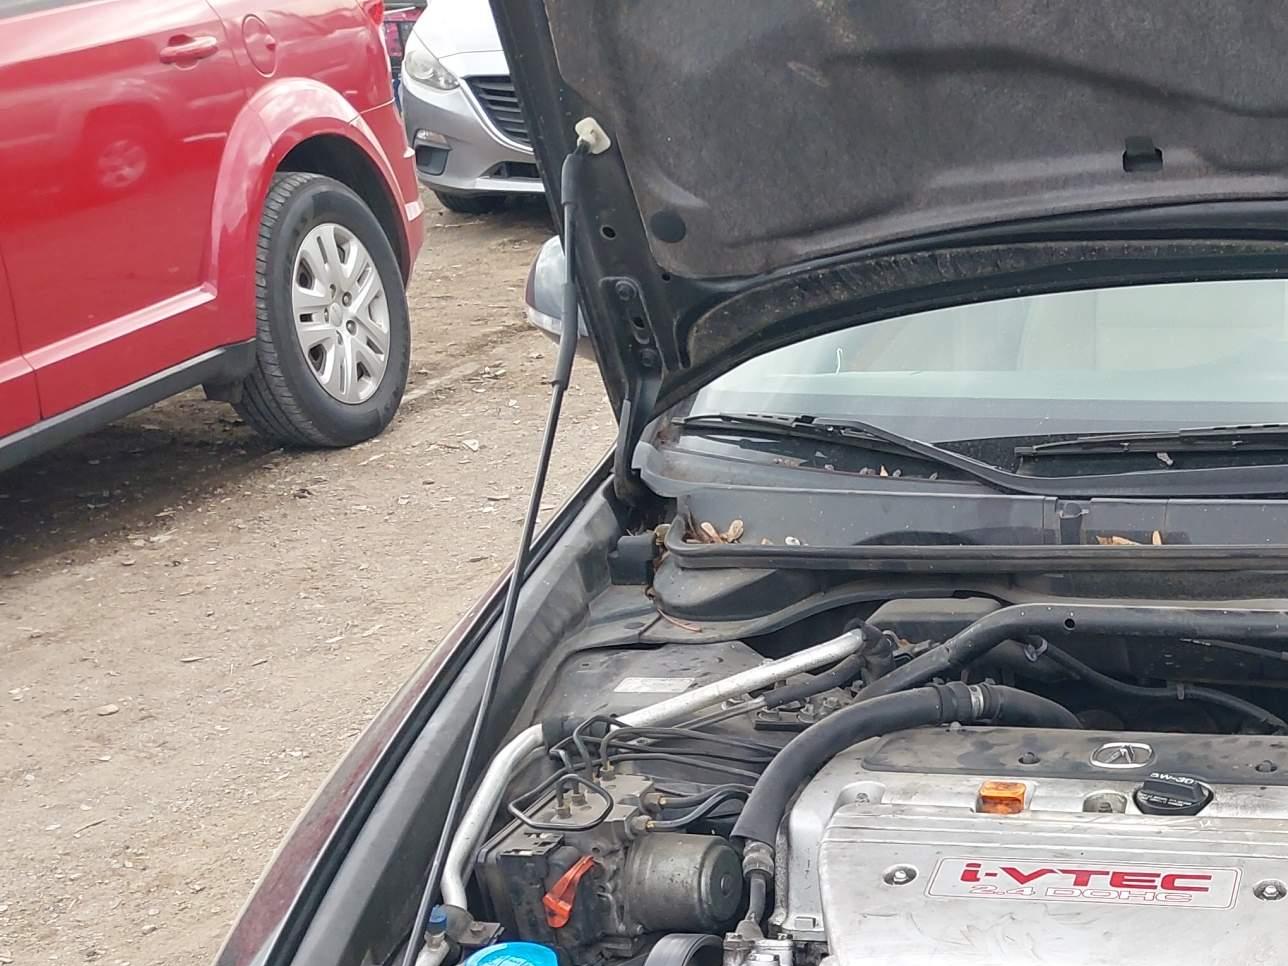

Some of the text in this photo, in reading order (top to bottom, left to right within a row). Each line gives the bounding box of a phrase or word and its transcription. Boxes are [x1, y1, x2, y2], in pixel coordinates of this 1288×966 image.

[960, 863, 1212, 892] i-VTEC
[969, 885, 1192, 903] 2.4 DOHC
